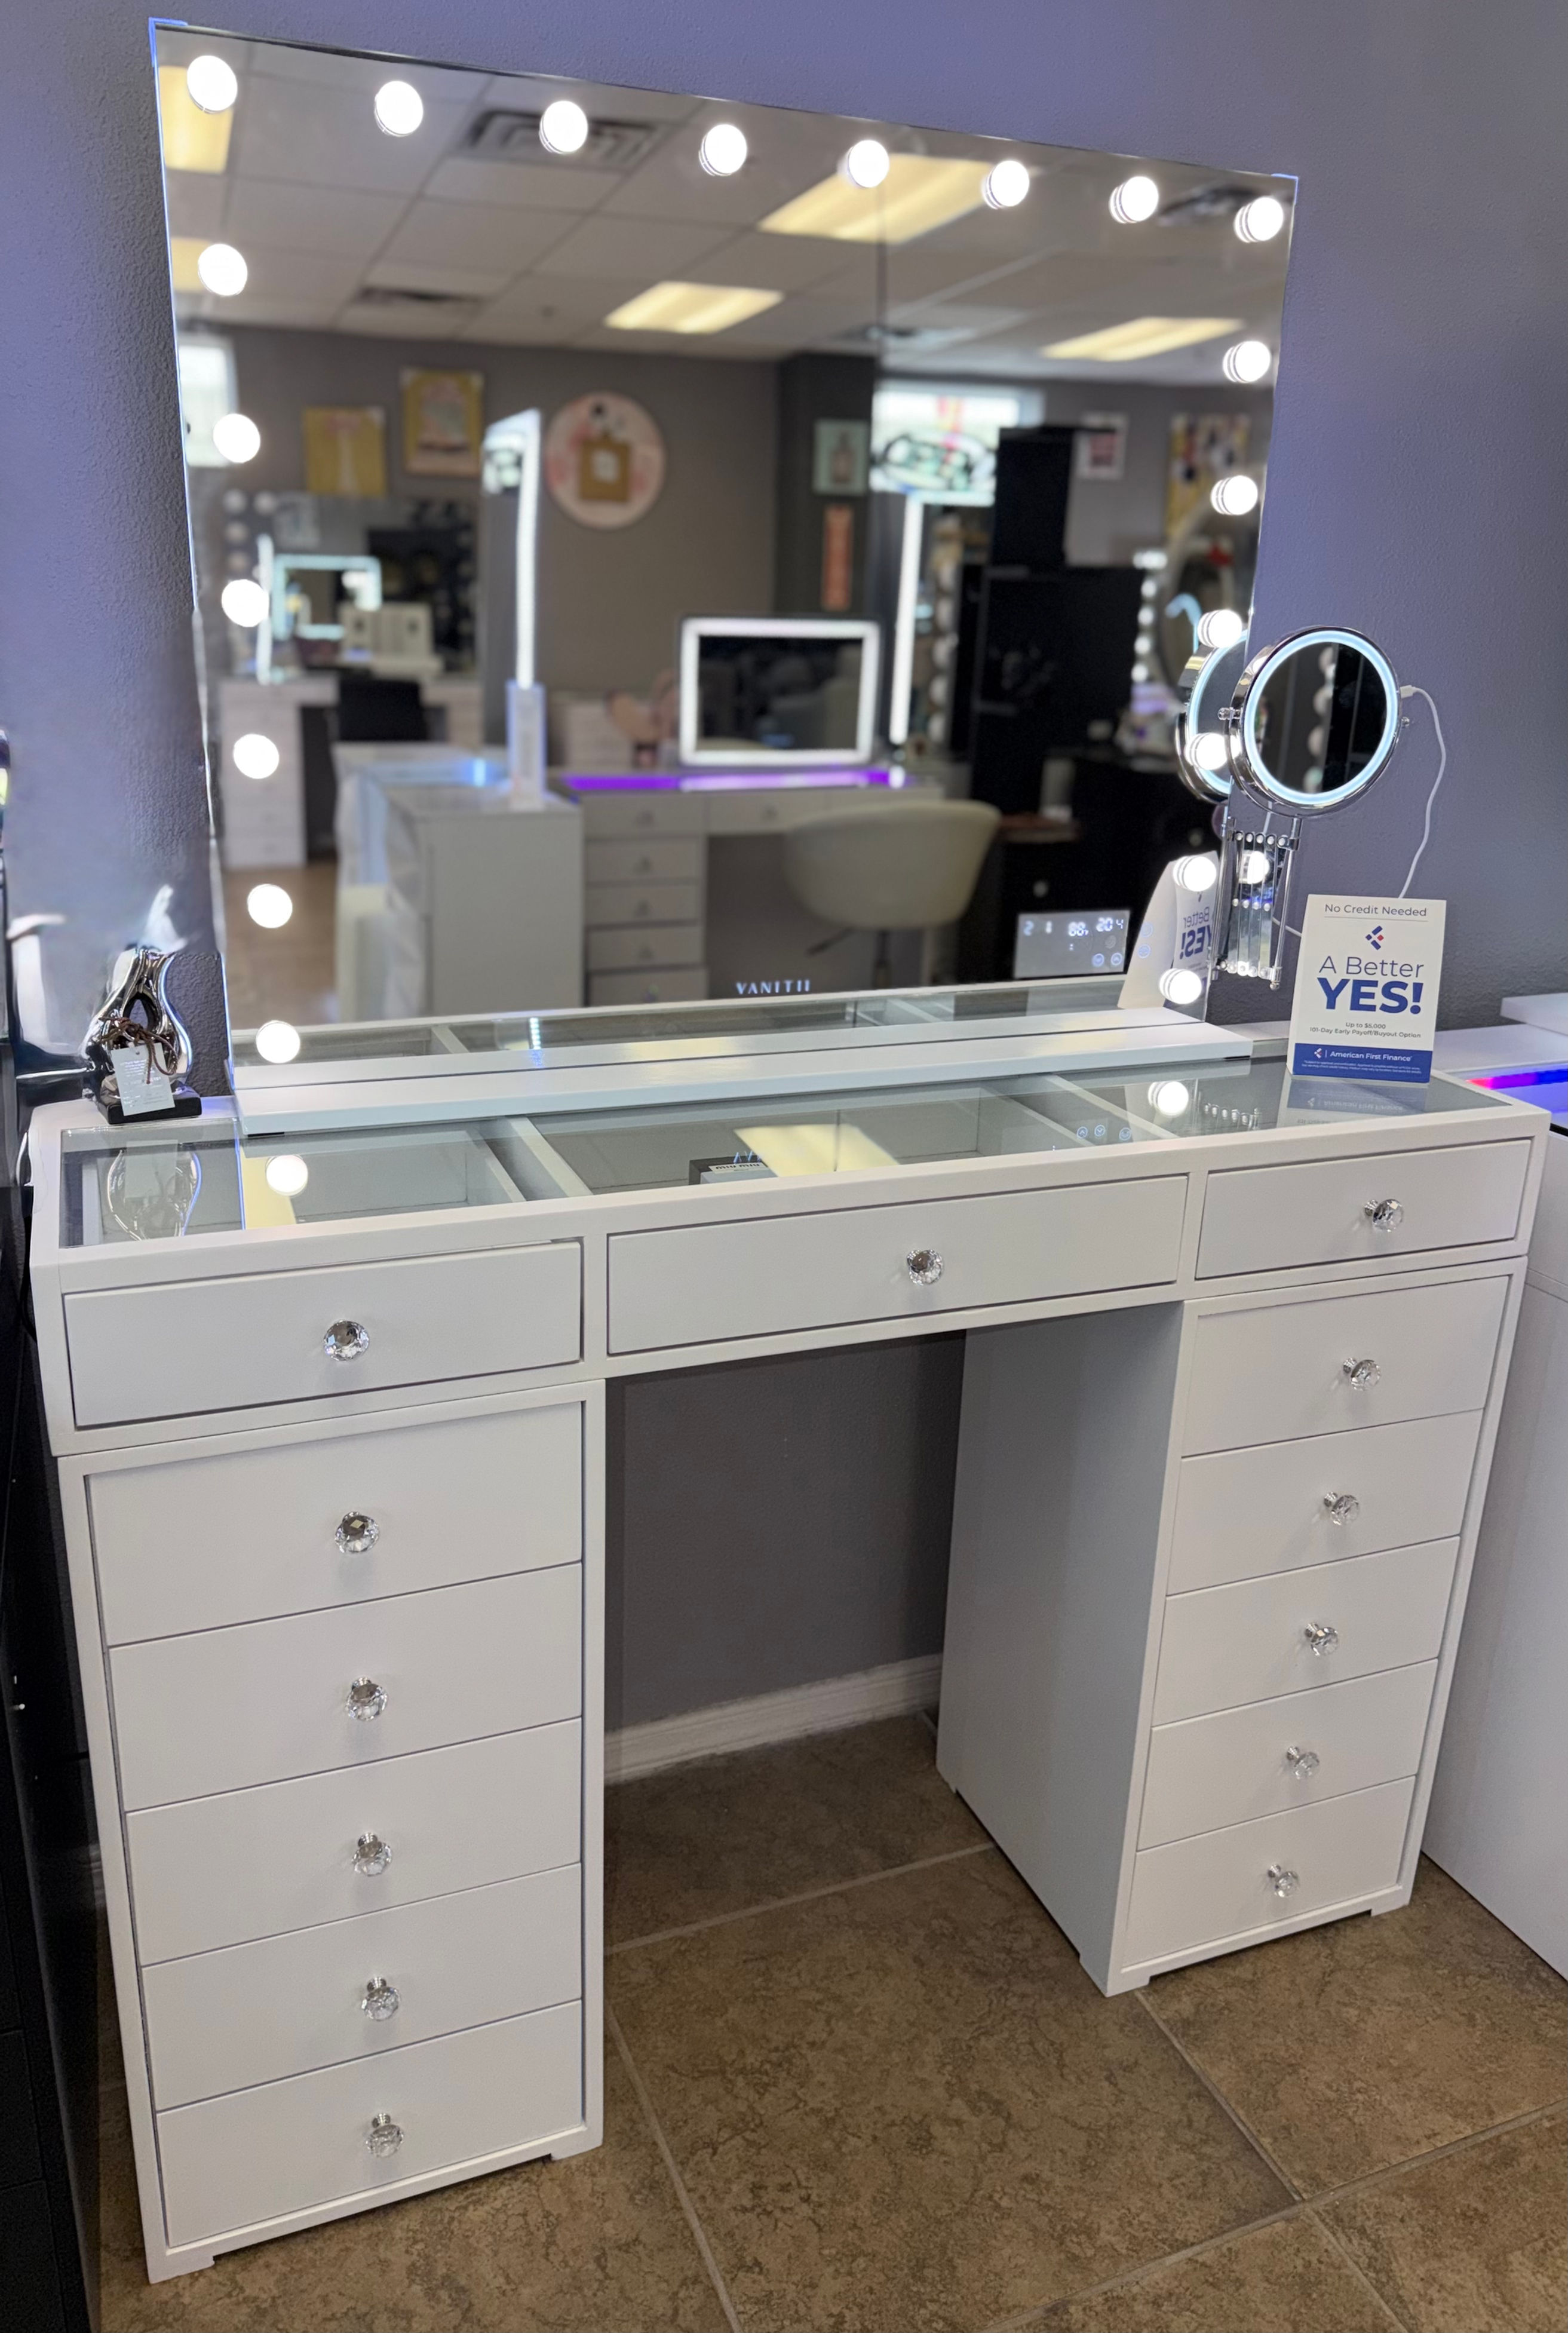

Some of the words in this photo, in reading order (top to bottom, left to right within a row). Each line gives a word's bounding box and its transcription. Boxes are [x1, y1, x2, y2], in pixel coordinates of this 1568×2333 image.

[1324, 904, 1340, 913] No
[1344, 904, 1379, 915] Credit
[1382, 906, 1427, 916] Needed
[1318, 955, 1337, 974] A
[1346, 956, 1424, 978] Better
[1317, 977, 1424, 1015] YES!
[1352, 1029, 1397, 1038] Payoff/Buyout
